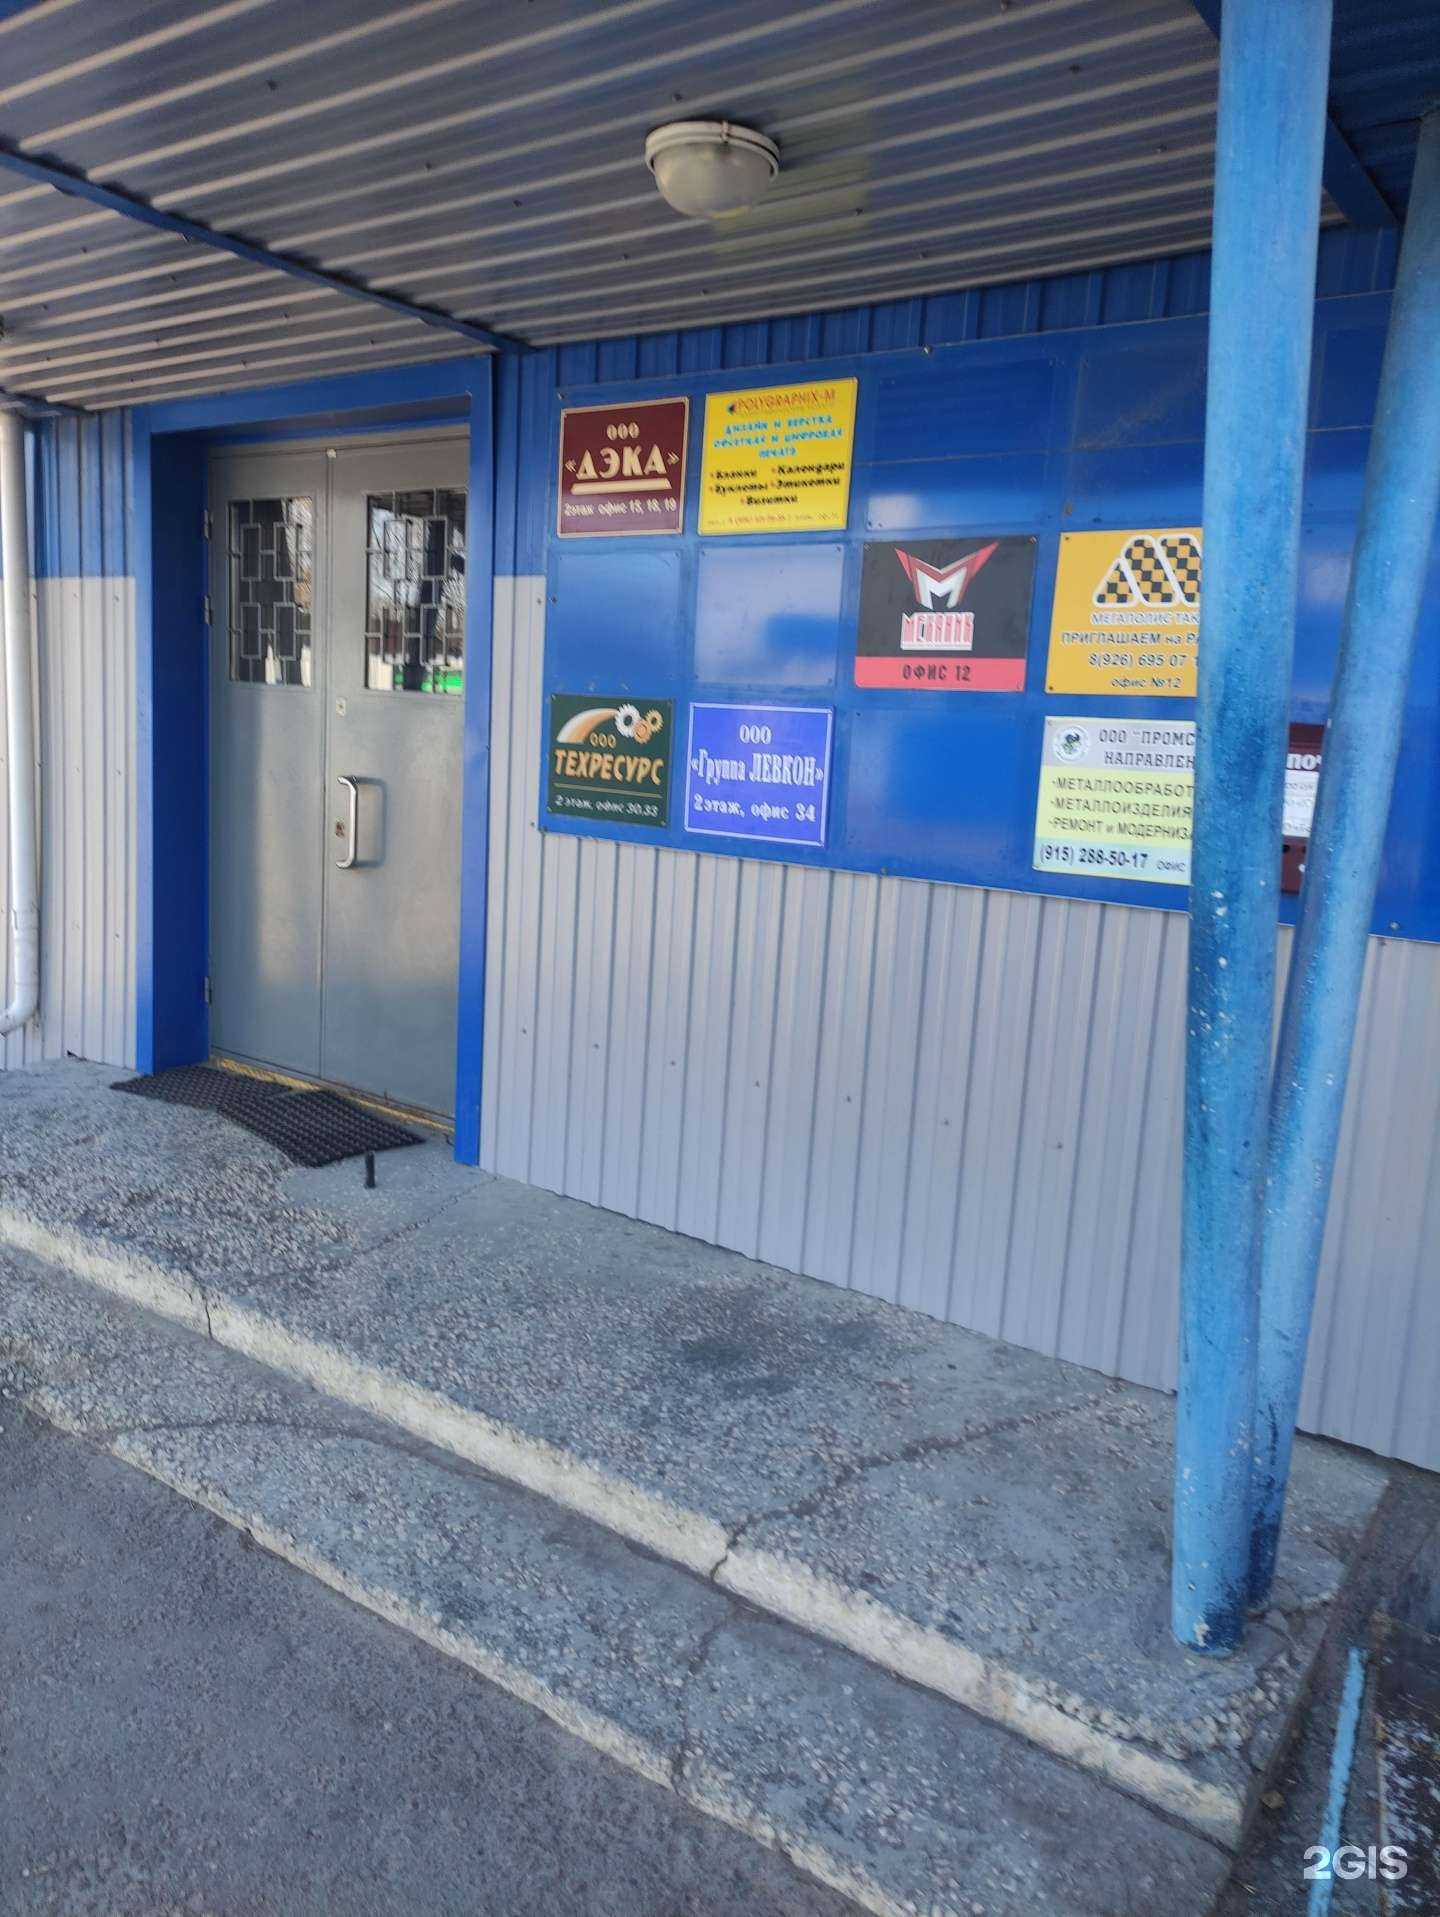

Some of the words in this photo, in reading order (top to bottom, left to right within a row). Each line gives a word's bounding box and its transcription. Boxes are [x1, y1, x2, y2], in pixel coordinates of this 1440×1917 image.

[606, 421, 641, 441] ООО
[565, 444, 681, 480] «ДЭКА»
[1061, 632, 1161, 646] ПРИГЛАШАЕМ
[902, 664, 947, 681] ОФИС
[956, 665, 972, 682] 12
[590, 731, 617, 748] ООО
[739, 724, 773, 744] ООО
[1098, 728, 1128, 743] ООО
[554, 749, 665, 786] ТЕХРЕСУРС
[690, 748, 746, 785] «Группа
[749, 752, 824, 787] ЛЕВКОН»
[751, 801, 790, 821] офис
[795, 803, 817, 823] 34
[1039, 844, 1074, 866] (915)
[1078, 847, 1149, 869] 288-50-17
